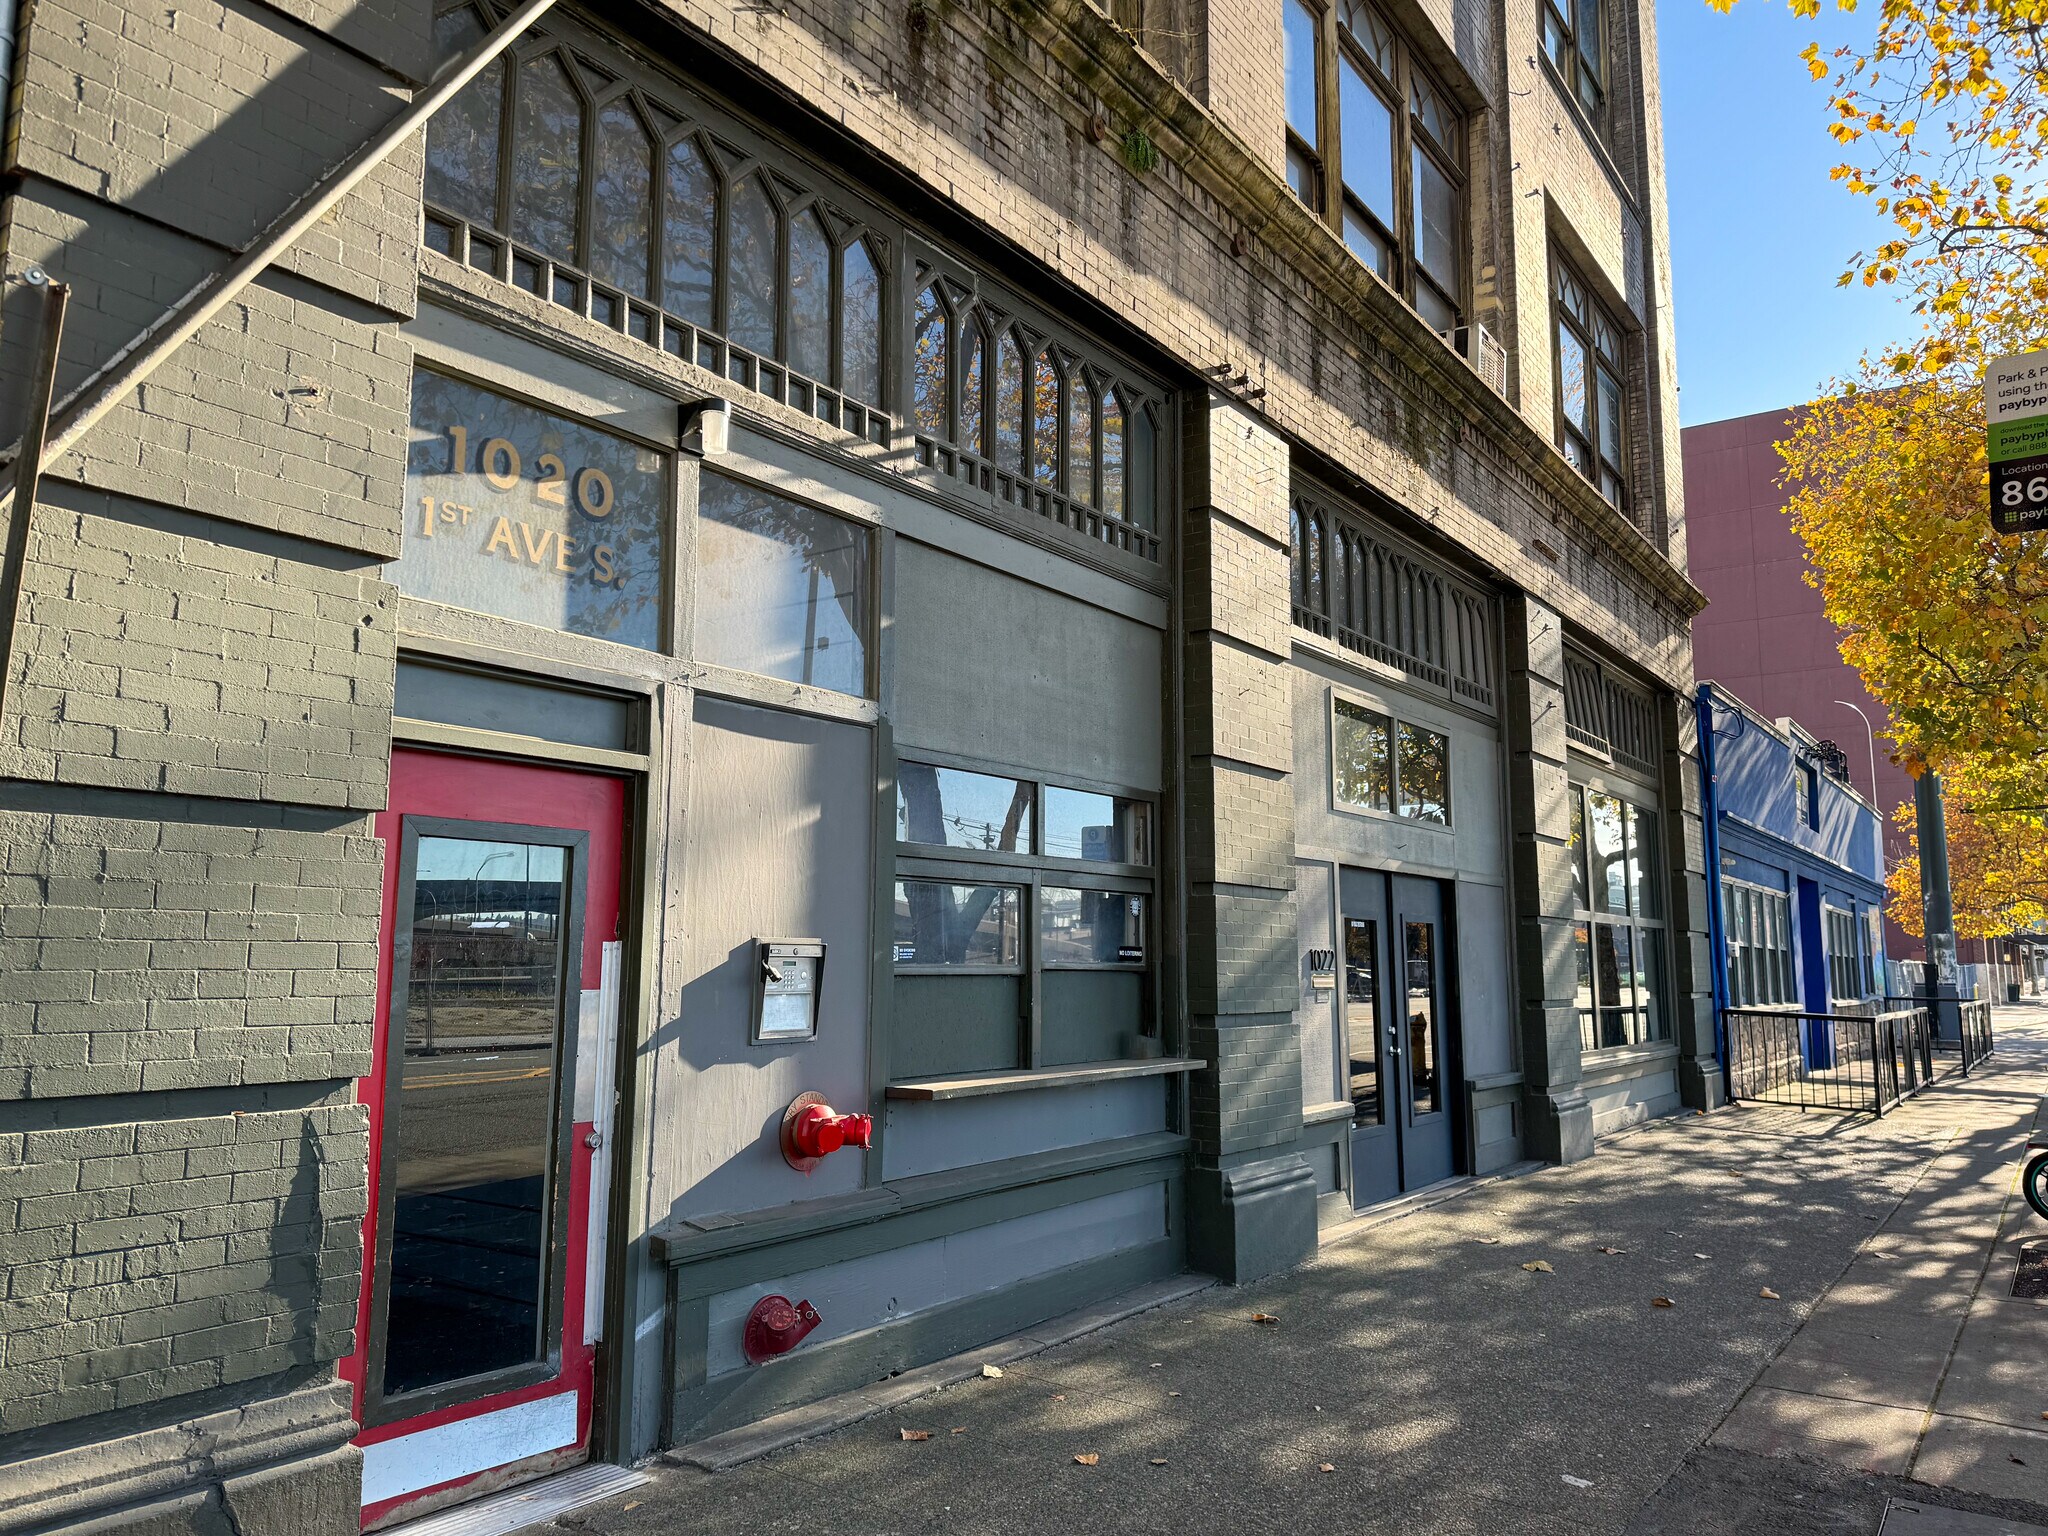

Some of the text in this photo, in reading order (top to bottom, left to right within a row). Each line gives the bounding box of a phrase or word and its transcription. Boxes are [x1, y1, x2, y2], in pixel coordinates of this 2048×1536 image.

[1998, 371, 2025, 385] Park
[2027, 368, 2037, 379] &
[1998, 381, 2048, 398] using th
[2012, 445, 2027, 454] call
[2029, 441, 2048, 451] 888
[445, 424, 614, 519] 1020
[2001, 462, 2048, 476] Location
[2001, 476, 2048, 505] 86
[420, 495, 625, 590] 1ST AVE S.
[1309, 948, 1336, 971] 1022
